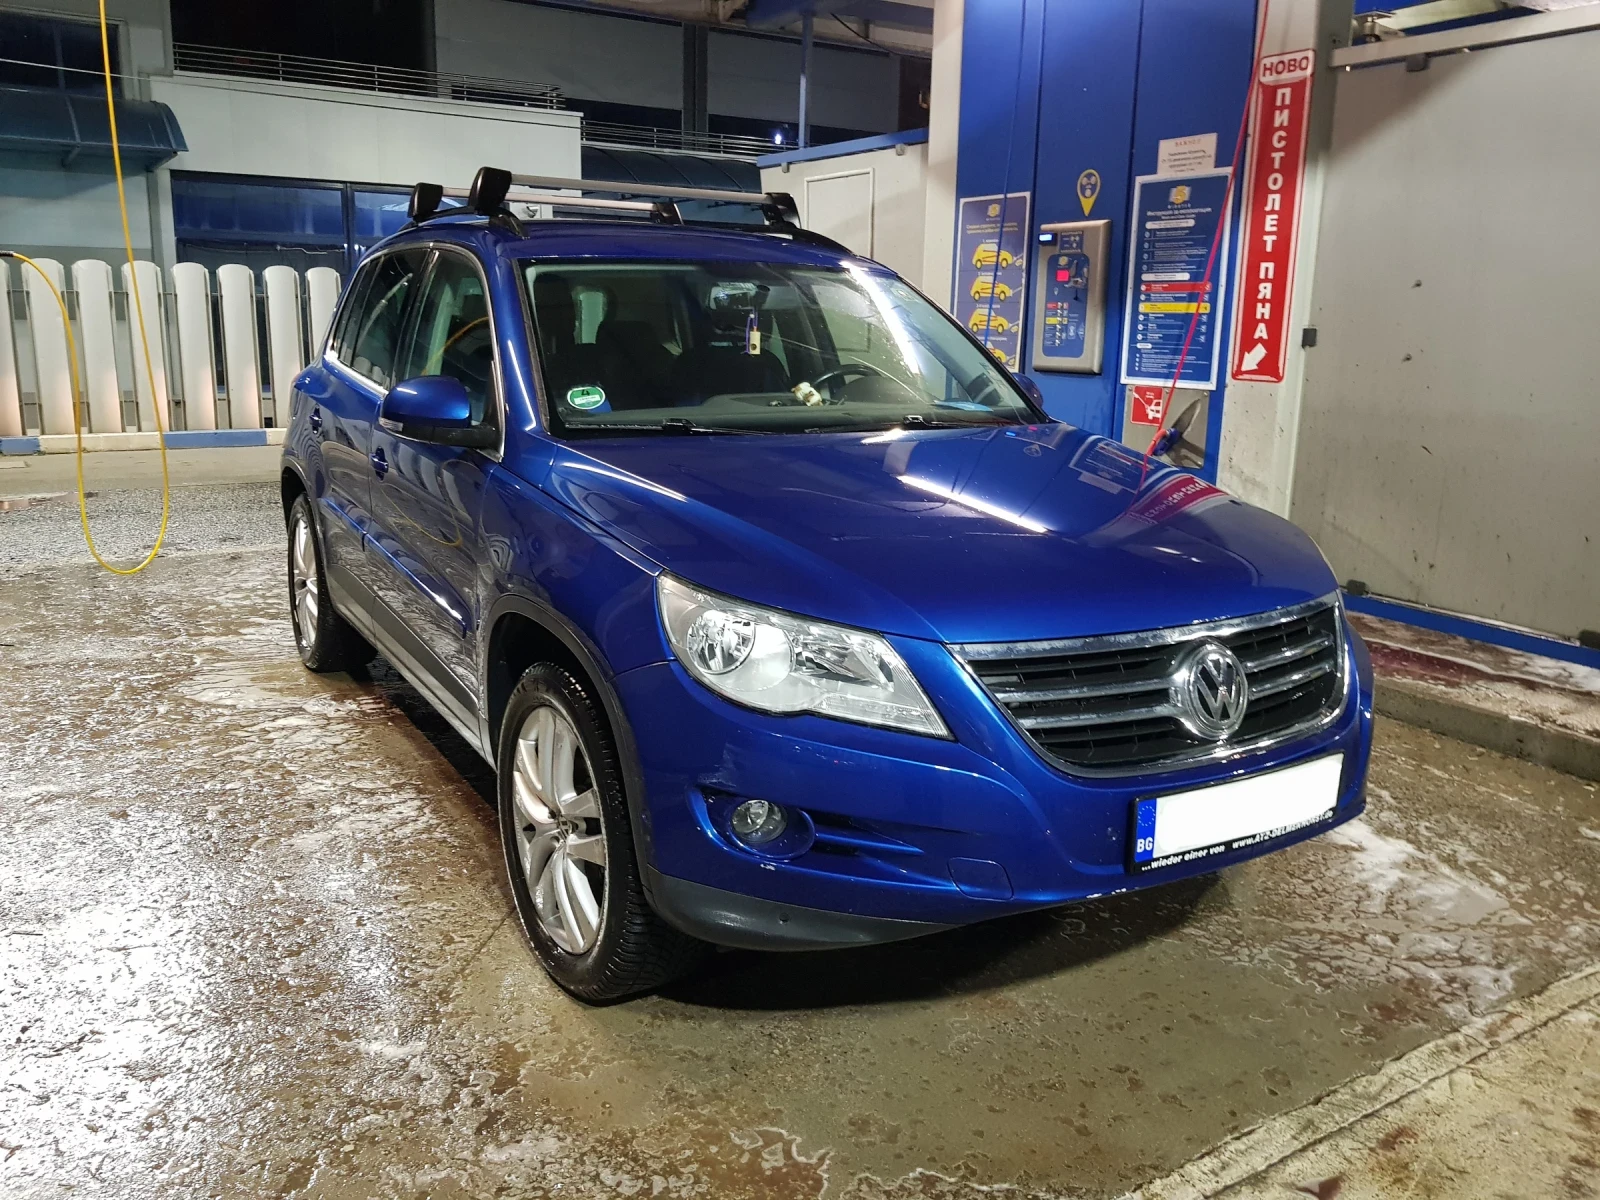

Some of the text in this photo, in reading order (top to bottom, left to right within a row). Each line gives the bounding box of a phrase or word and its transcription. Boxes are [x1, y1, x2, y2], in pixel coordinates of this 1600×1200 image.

[1262, 55, 1310, 78] НОВО
[1253, 87, 1292, 341] ПИСТОЛЕТ ПЯНА
[1136, 836, 1154, 853] BG
[1184, 848, 1208, 861] einer
[1209, 844, 1225, 855] von
